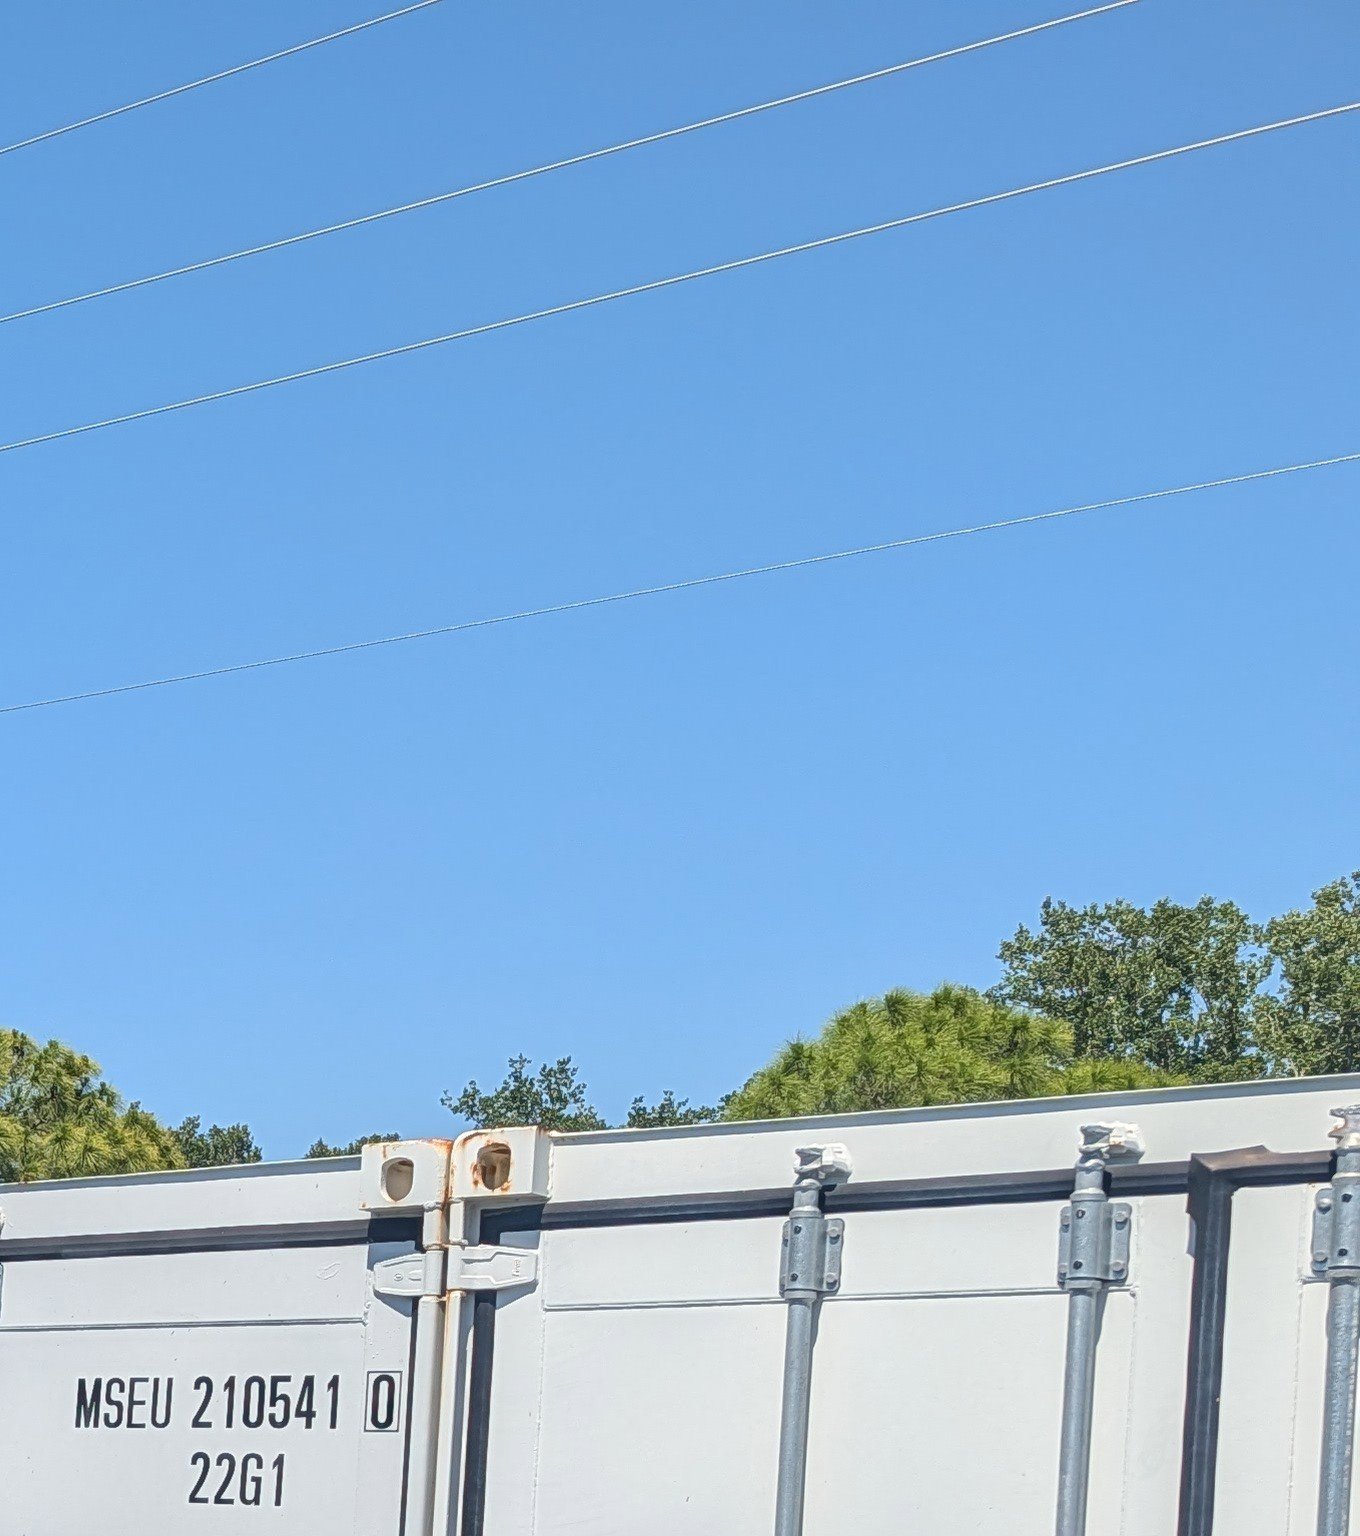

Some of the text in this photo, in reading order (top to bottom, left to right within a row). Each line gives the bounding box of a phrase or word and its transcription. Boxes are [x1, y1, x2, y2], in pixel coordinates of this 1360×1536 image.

[75, 1377, 174, 1429] MSEU
[191, 1374, 340, 1429] 210541
[188, 1451, 285, 1507] 22G1
